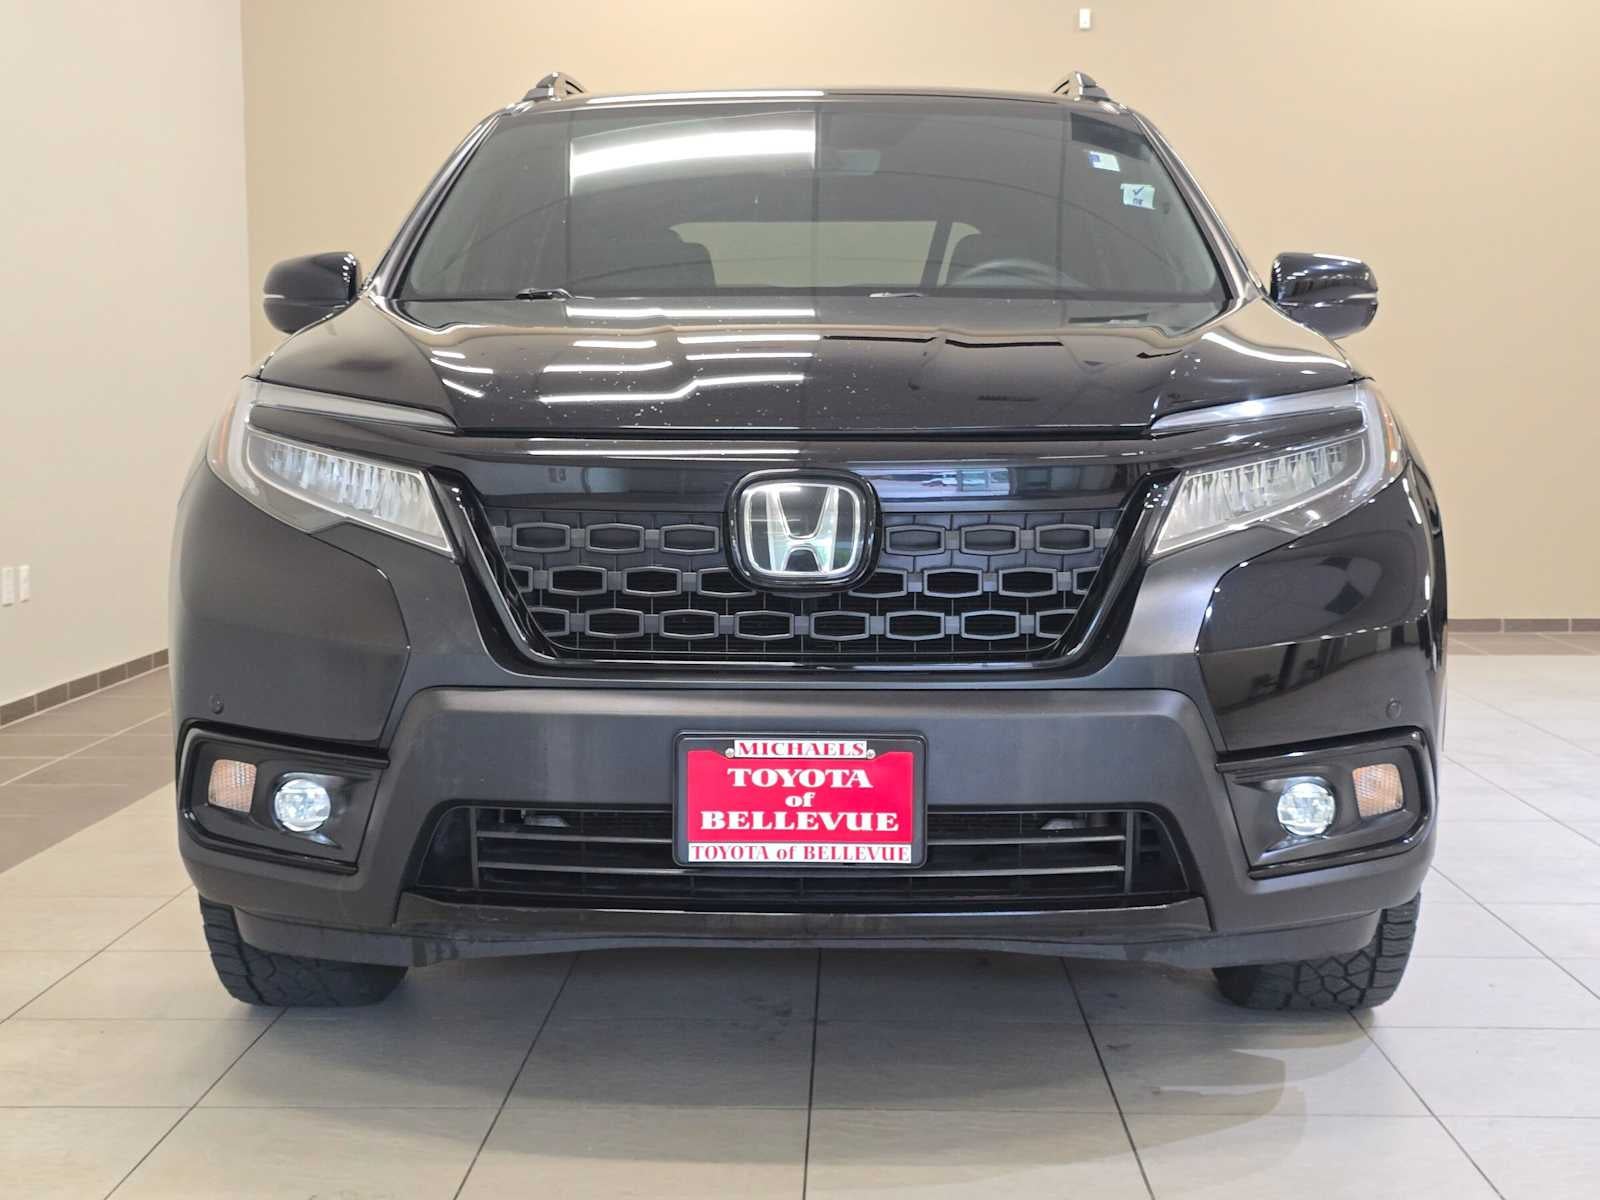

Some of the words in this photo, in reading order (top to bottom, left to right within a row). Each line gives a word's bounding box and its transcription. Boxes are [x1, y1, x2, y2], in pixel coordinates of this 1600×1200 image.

[738, 742, 865, 756] MICHAELS
[727, 768, 873, 788] TOYOTA
[785, 792, 816, 807] of
[701, 811, 898, 831] BELLEVUE
[691, 845, 769, 860] TOYOTA
[776, 846, 797, 860] of
[804, 846, 910, 861] BELLEVUE
